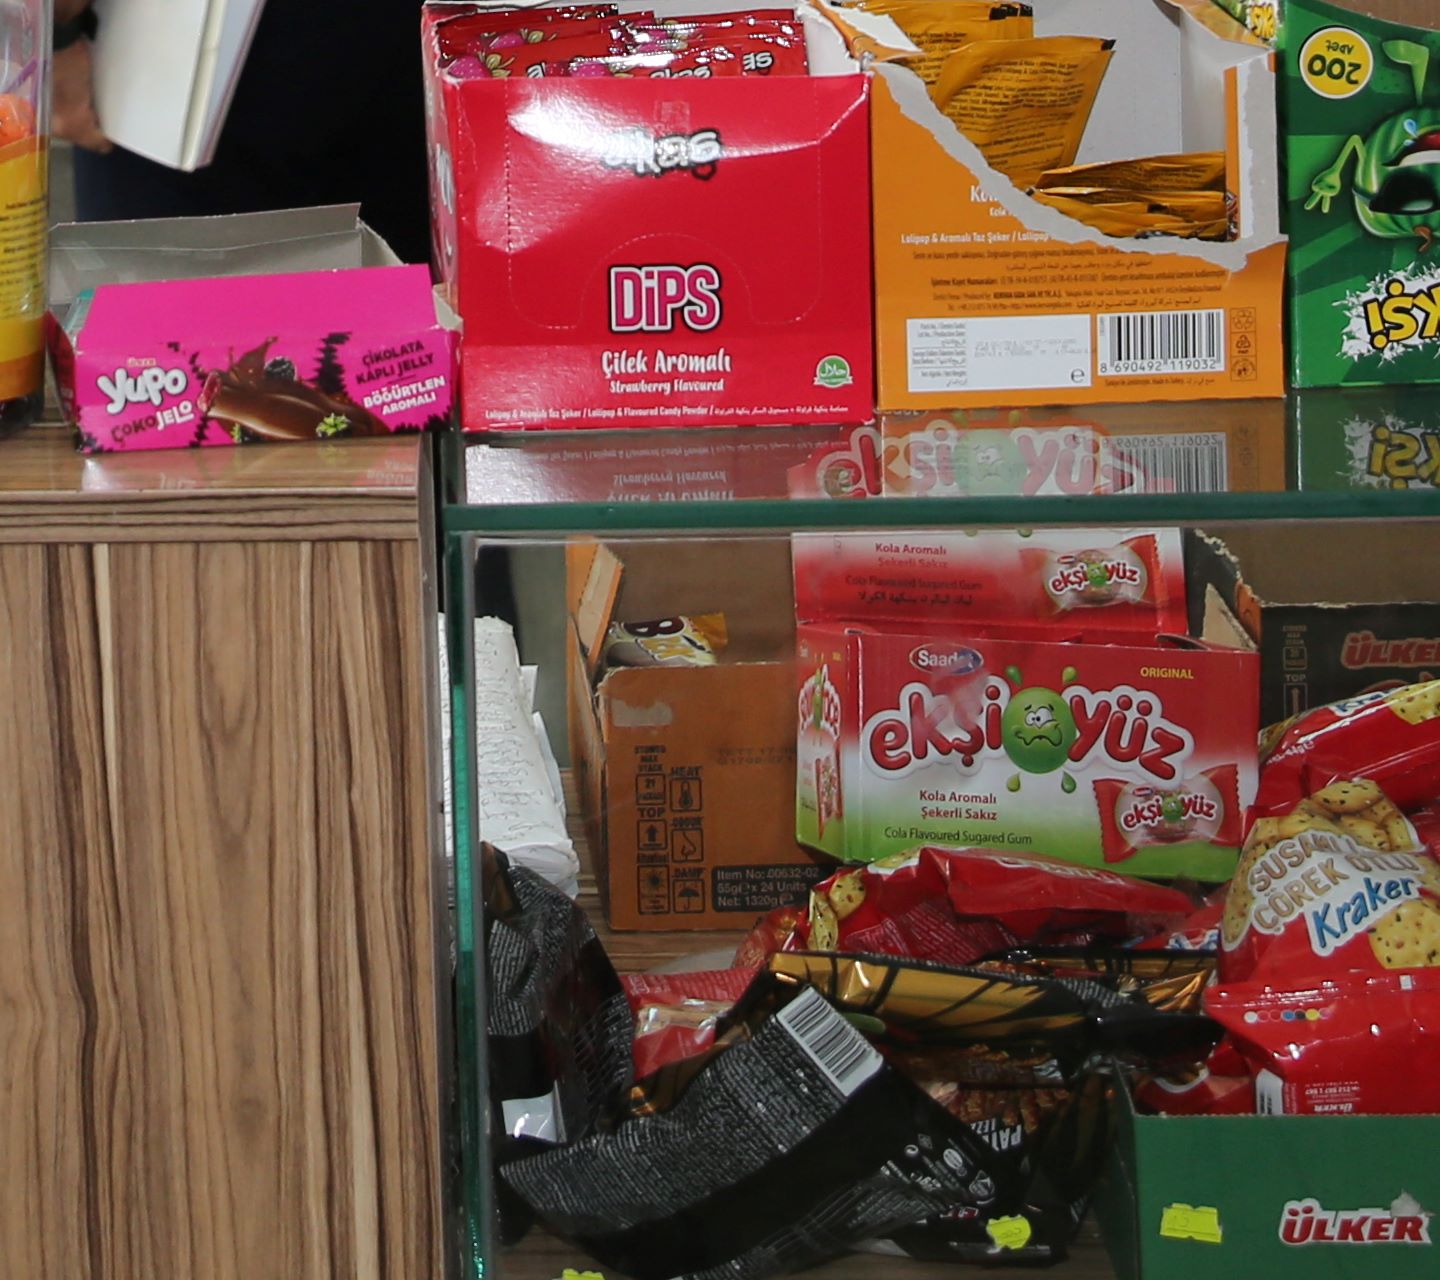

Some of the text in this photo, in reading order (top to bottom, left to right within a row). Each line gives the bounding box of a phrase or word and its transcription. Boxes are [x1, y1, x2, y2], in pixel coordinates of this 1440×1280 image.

[1306, 52, 1362, 85] 200
[355, 352, 435, 385] KAPLI JELLY
[601, 347, 732, 380] Çilek Aromalı
[1099, 358, 1218, 373] 8 690492 119032
[361, 374, 446, 410] BÖĞÜRTLEN
[608, 378, 725, 396] Strawberry Flavoured
[381, 391, 438, 417] AROMALI
[875, 542, 948, 557] Kola Aromalı
[1139, 666, 1195, 680] ORIGINAL
[1068, 693, 1187, 782] yüz
[670, 766, 703, 777] HEAT
[919, 789, 997, 804] Kola Aromalı
[1181, 792, 1216, 818] yüz
[637, 807, 667, 818] TOP
[920, 805, 998, 821] Şekerli Sakız
[884, 826, 1032, 845] Cola Flavoured Sugared Gum
[716, 868, 766, 881] Item No:
[776, 880, 807, 892] Units
[718, 895, 741, 907] Net:
[1252, 863, 1349, 934] ÇÖREK
[1307, 873, 1417, 951] Kraker
[1278, 1196, 1433, 1247] ÜLKER
